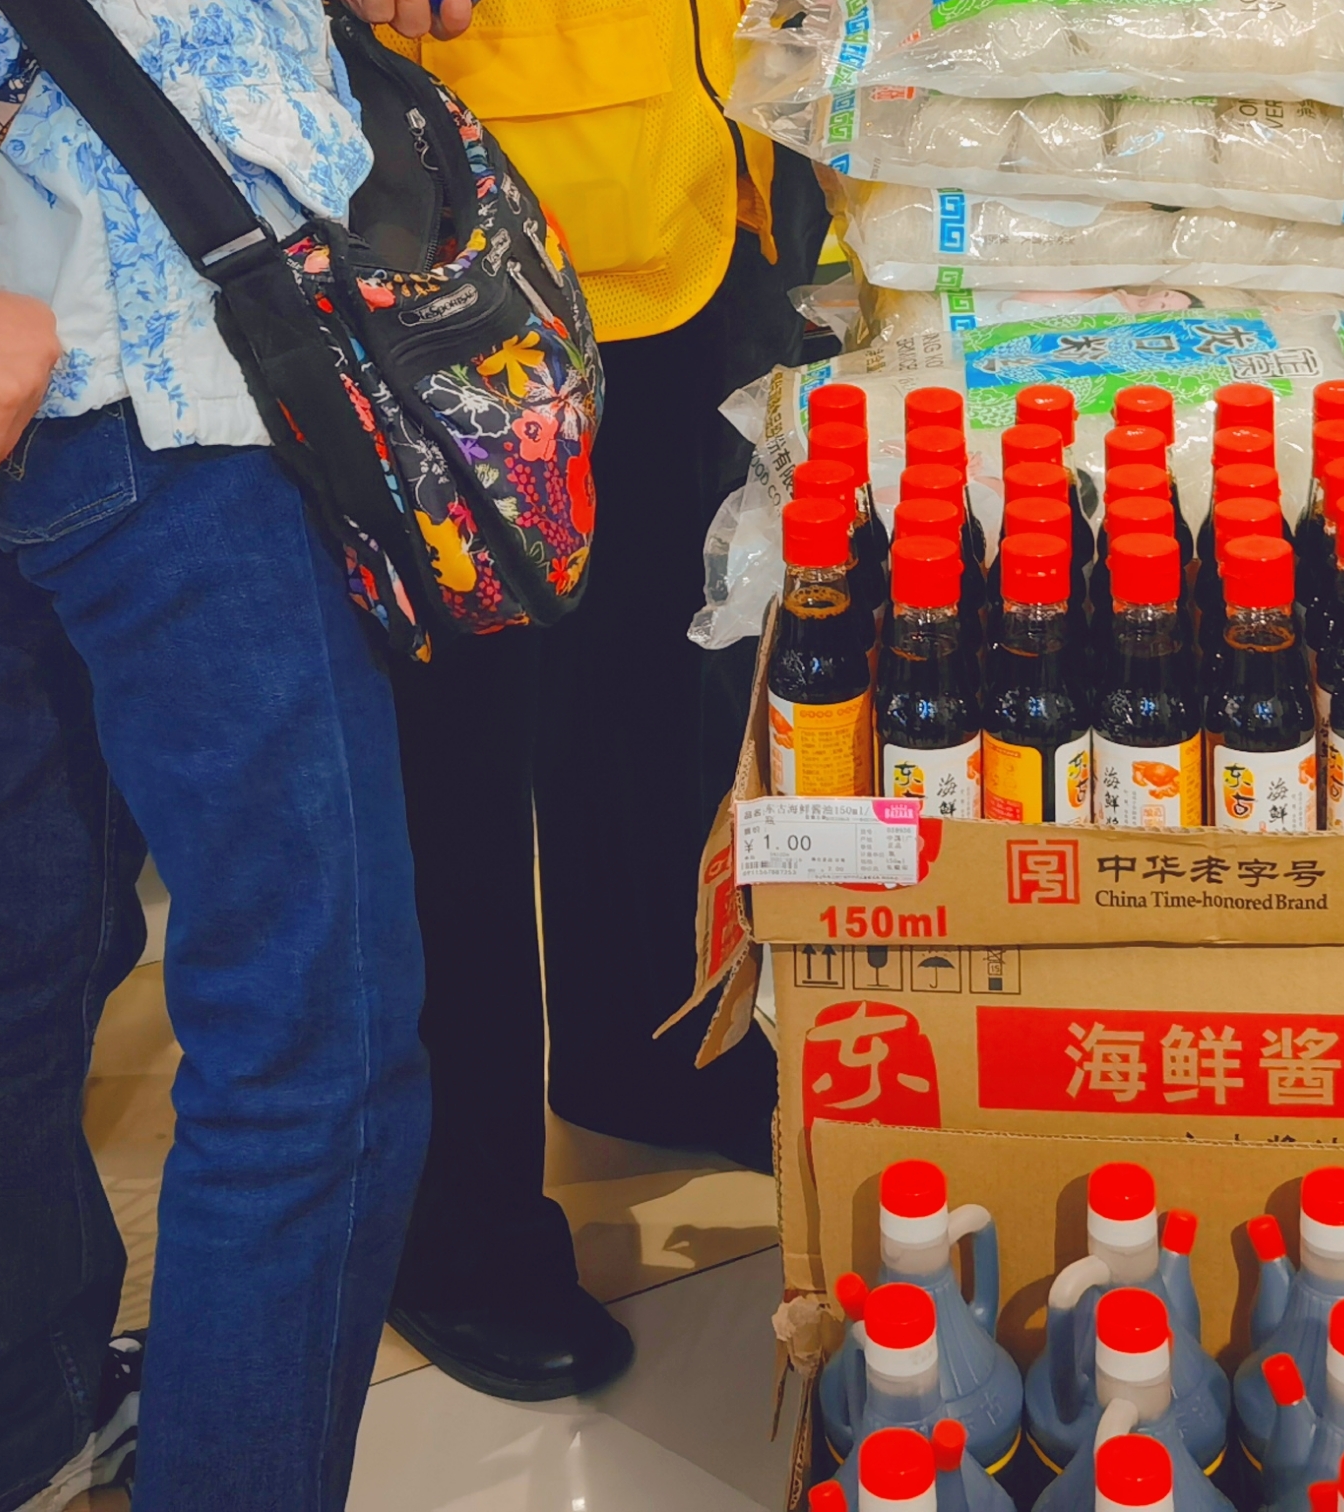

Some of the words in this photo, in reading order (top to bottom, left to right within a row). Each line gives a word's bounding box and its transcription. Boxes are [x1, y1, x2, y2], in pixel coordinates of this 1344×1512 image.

[1222, 764, 1258, 816] 东古
[744, 839, 754, 853] ¥
[763, 834, 812, 851] 1.00
[1096, 853, 1328, 890] 中华老字号
[1094, 889, 1146, 910] China
[1150, 890, 1274, 912] Time-honored
[1275, 891, 1329, 912] Brand
[818, 905, 949, 940] 150ml
